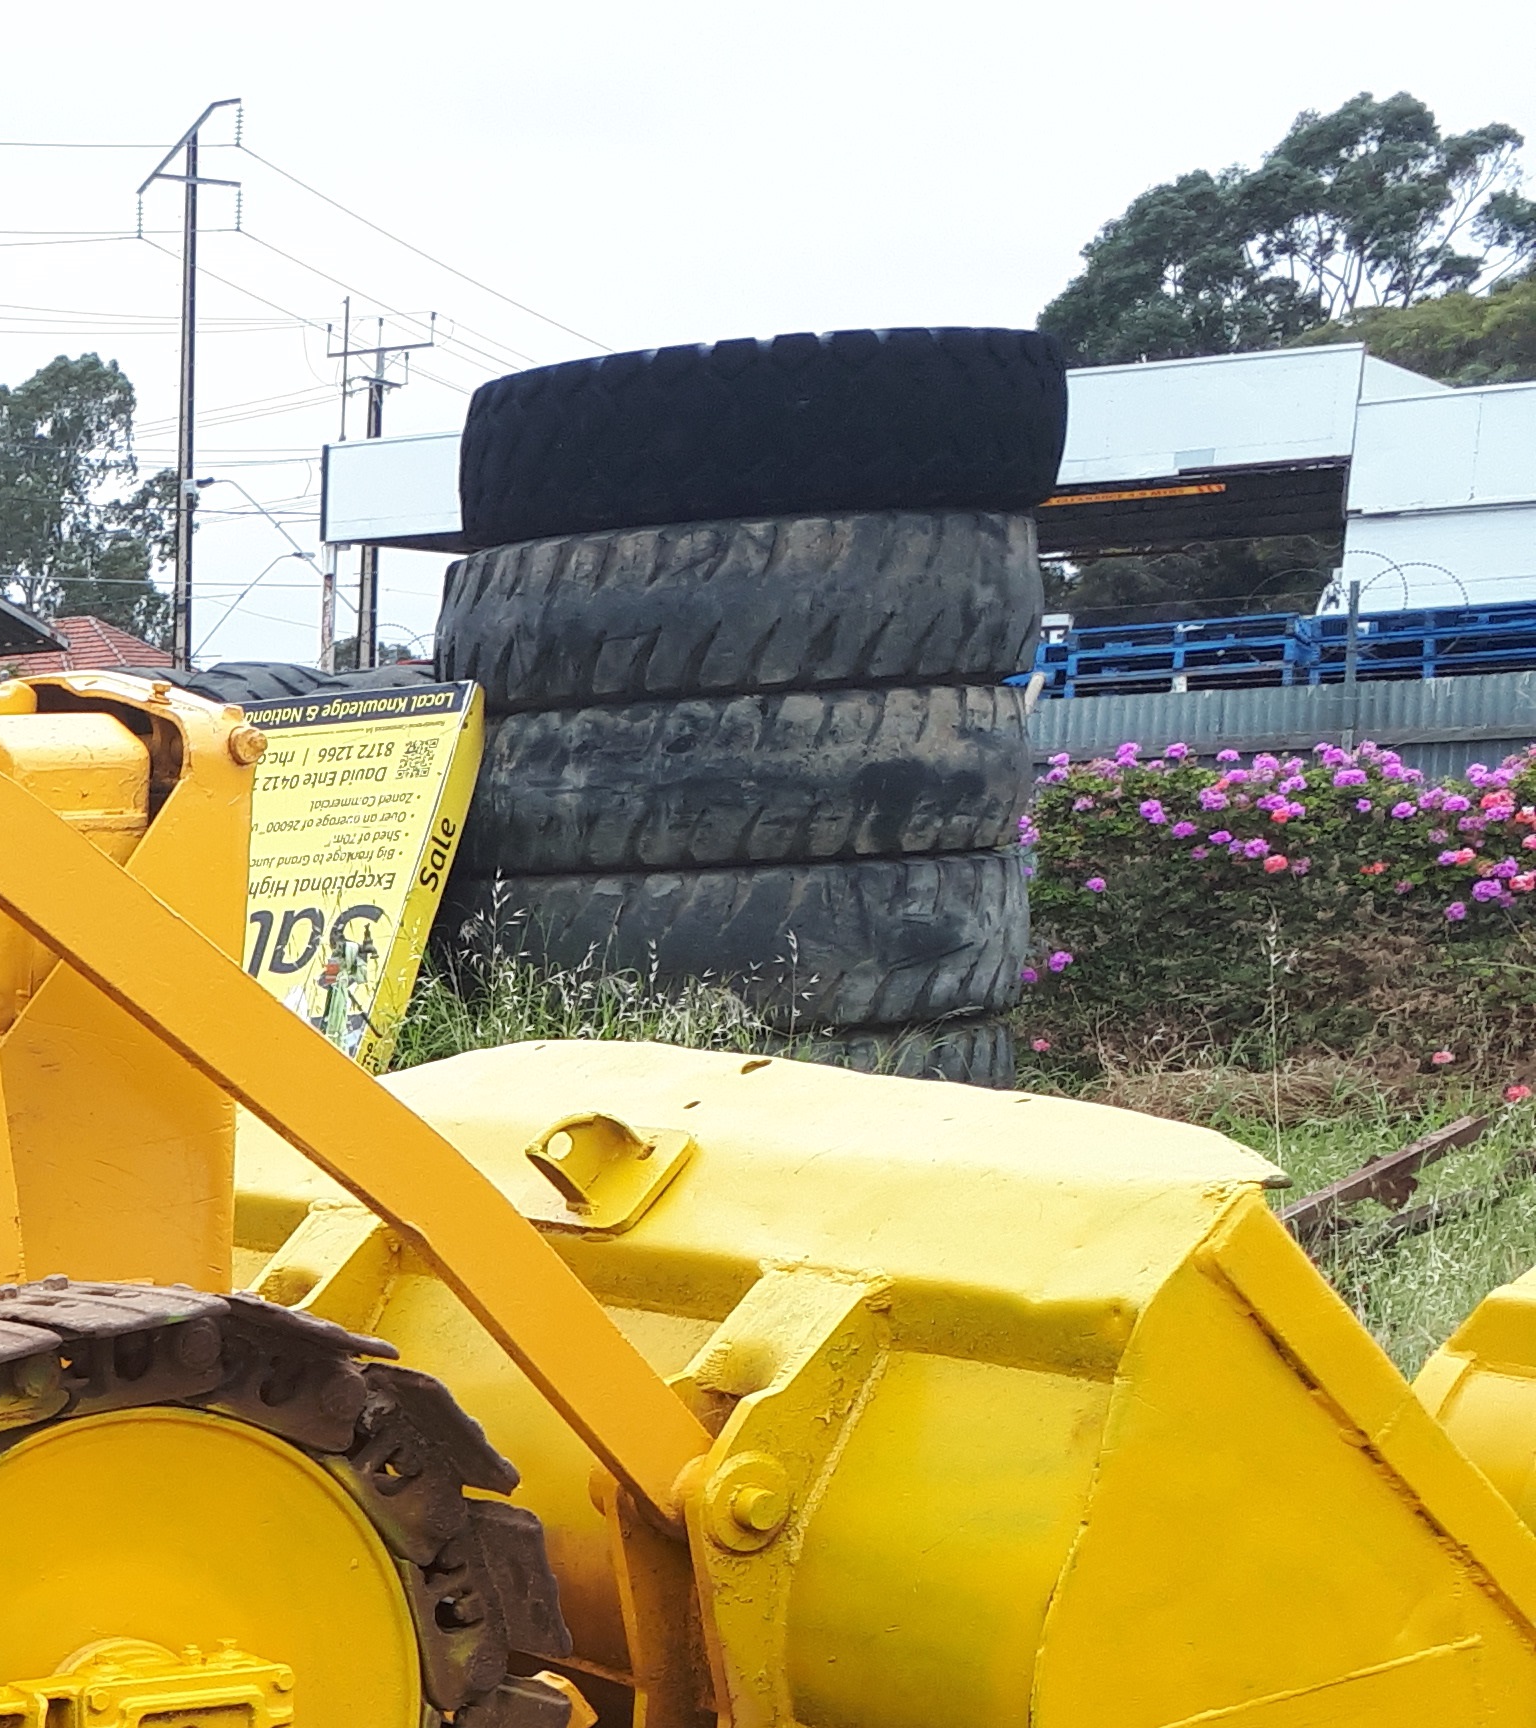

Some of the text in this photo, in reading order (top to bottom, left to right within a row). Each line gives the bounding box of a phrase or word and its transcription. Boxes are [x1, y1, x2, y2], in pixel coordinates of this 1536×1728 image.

[321, 697, 408, 718] Knowledge
[410, 692, 454, 712] Local
[306, 706, 319, 721] &
[318, 745, 354, 764] 1266
[358, 741, 395, 760] 8172
[262, 774, 300, 791] 0412
[303, 770, 337, 788] Ente
[340, 767, 387, 786] David
[310, 793, 414, 812] Zoned Commercial
[302, 819, 314, 833] of
[363, 814, 377, 825] an
[380, 812, 406, 824] Over
[359, 832, 371, 844] of
[374, 830, 401, 842] Shed
[276, 855, 310, 868] Grand
[313, 854, 324, 865] to
[326, 849, 374, 864] frontage
[377, 847, 395, 860] Big
[419, 816, 456, 893] Sale
[293, 870, 396, 897] Exceptional
